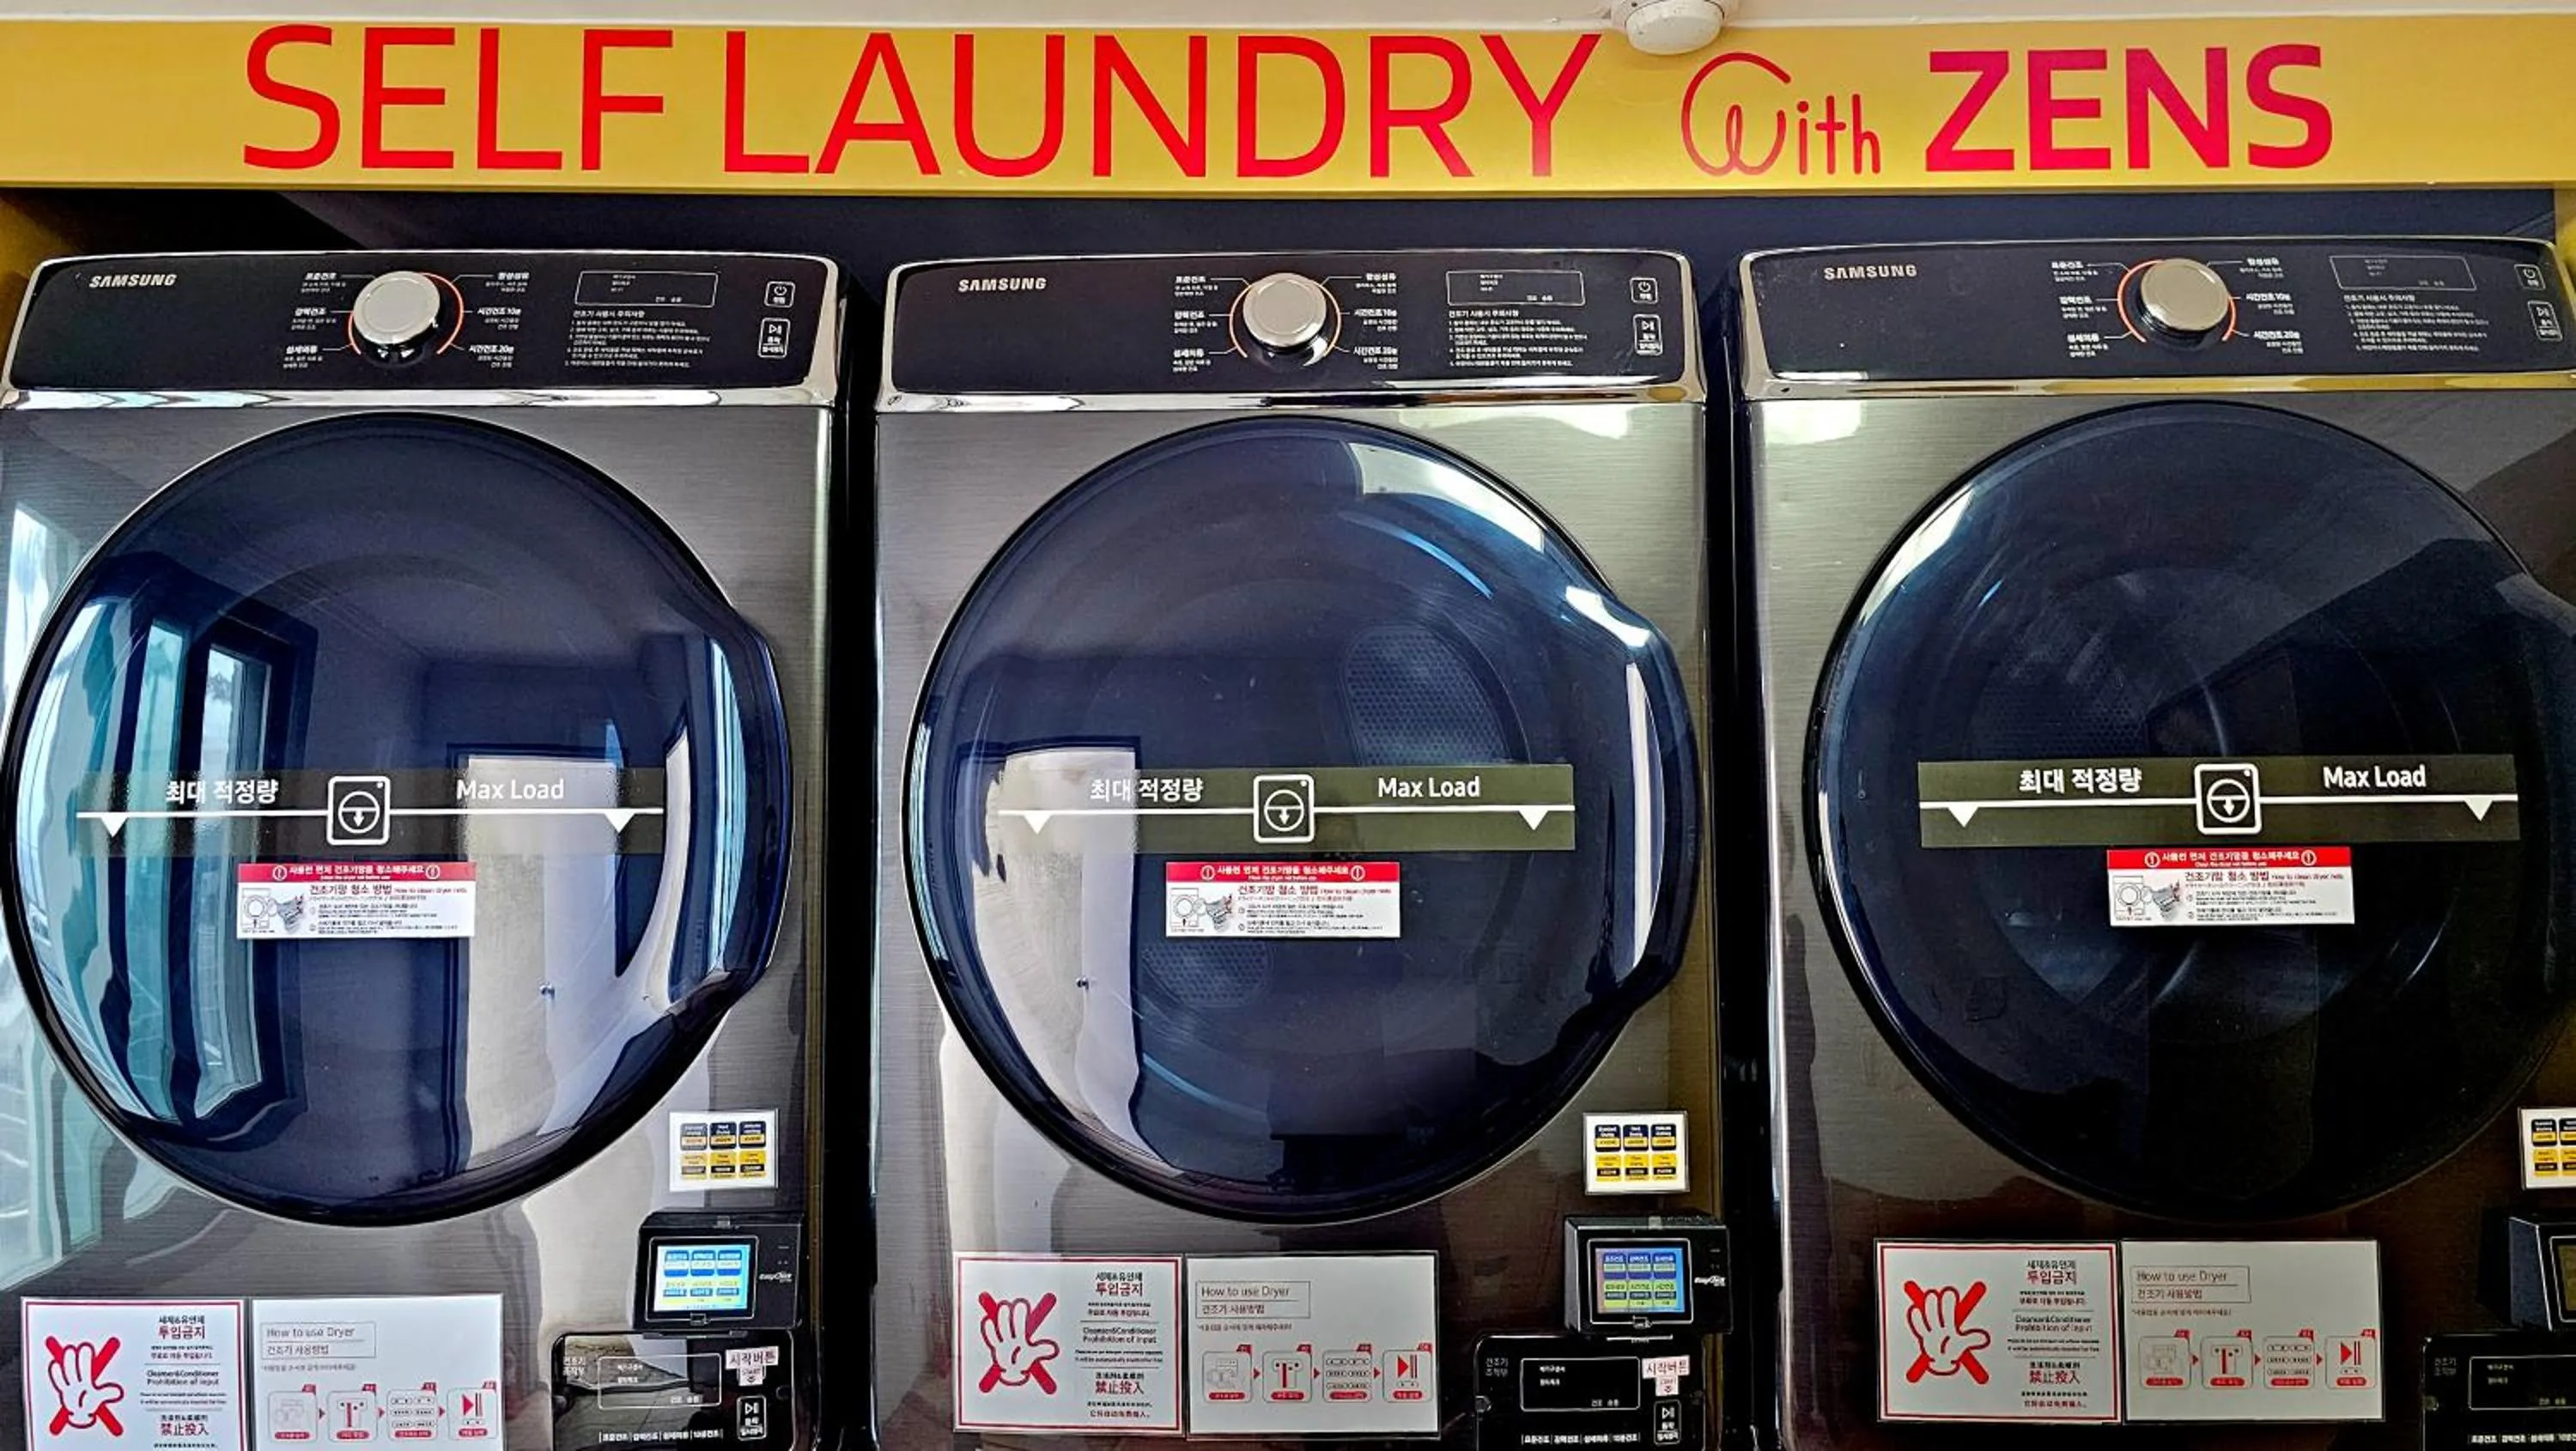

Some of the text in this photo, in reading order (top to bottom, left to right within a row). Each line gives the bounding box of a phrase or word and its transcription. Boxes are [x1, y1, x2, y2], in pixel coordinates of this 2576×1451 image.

[244, 23, 2333, 177] SELF LAUNDRY With ZENS
[1824, 264, 1917, 280] SAMSUNG
[88, 274, 177, 288] SAMSUNG
[957, 277, 1047, 292] SAMSUNG
[2019, 767, 2142, 793] 최대 적정량
[2324, 764, 2427, 789] Max Load
[166, 779, 279, 805] 최대 적정량
[457, 779, 565, 802] Max Load
[1090, 777, 1204, 804] 최대 적정량
[1378, 775, 1481, 798] Max Load
[2027, 1271, 2076, 1285] 투입금지
[2137, 1270, 2227, 1283] How to use Dryer
[1096, 1283, 1143, 1296] 투입금지
[1202, 1285, 1290, 1298] How to use Dryer
[2138, 1289, 2164, 1299] 건조기
[1202, 1304, 1226, 1314] 건조기
[159, 1326, 205, 1339] 투입금지
[268, 1327, 289, 1338] How
[293, 1328, 303, 1337] to
[327, 1327, 355, 1339] Dryer
[268, 1345, 292, 1355] 건조기
[729, 1351, 775, 1366] 시작버튼
[2030, 1370, 2081, 1384] 禁止投入
[1096, 1381, 1145, 1394] 禁止投入
[161, 1423, 209, 1436] 禁止投入
